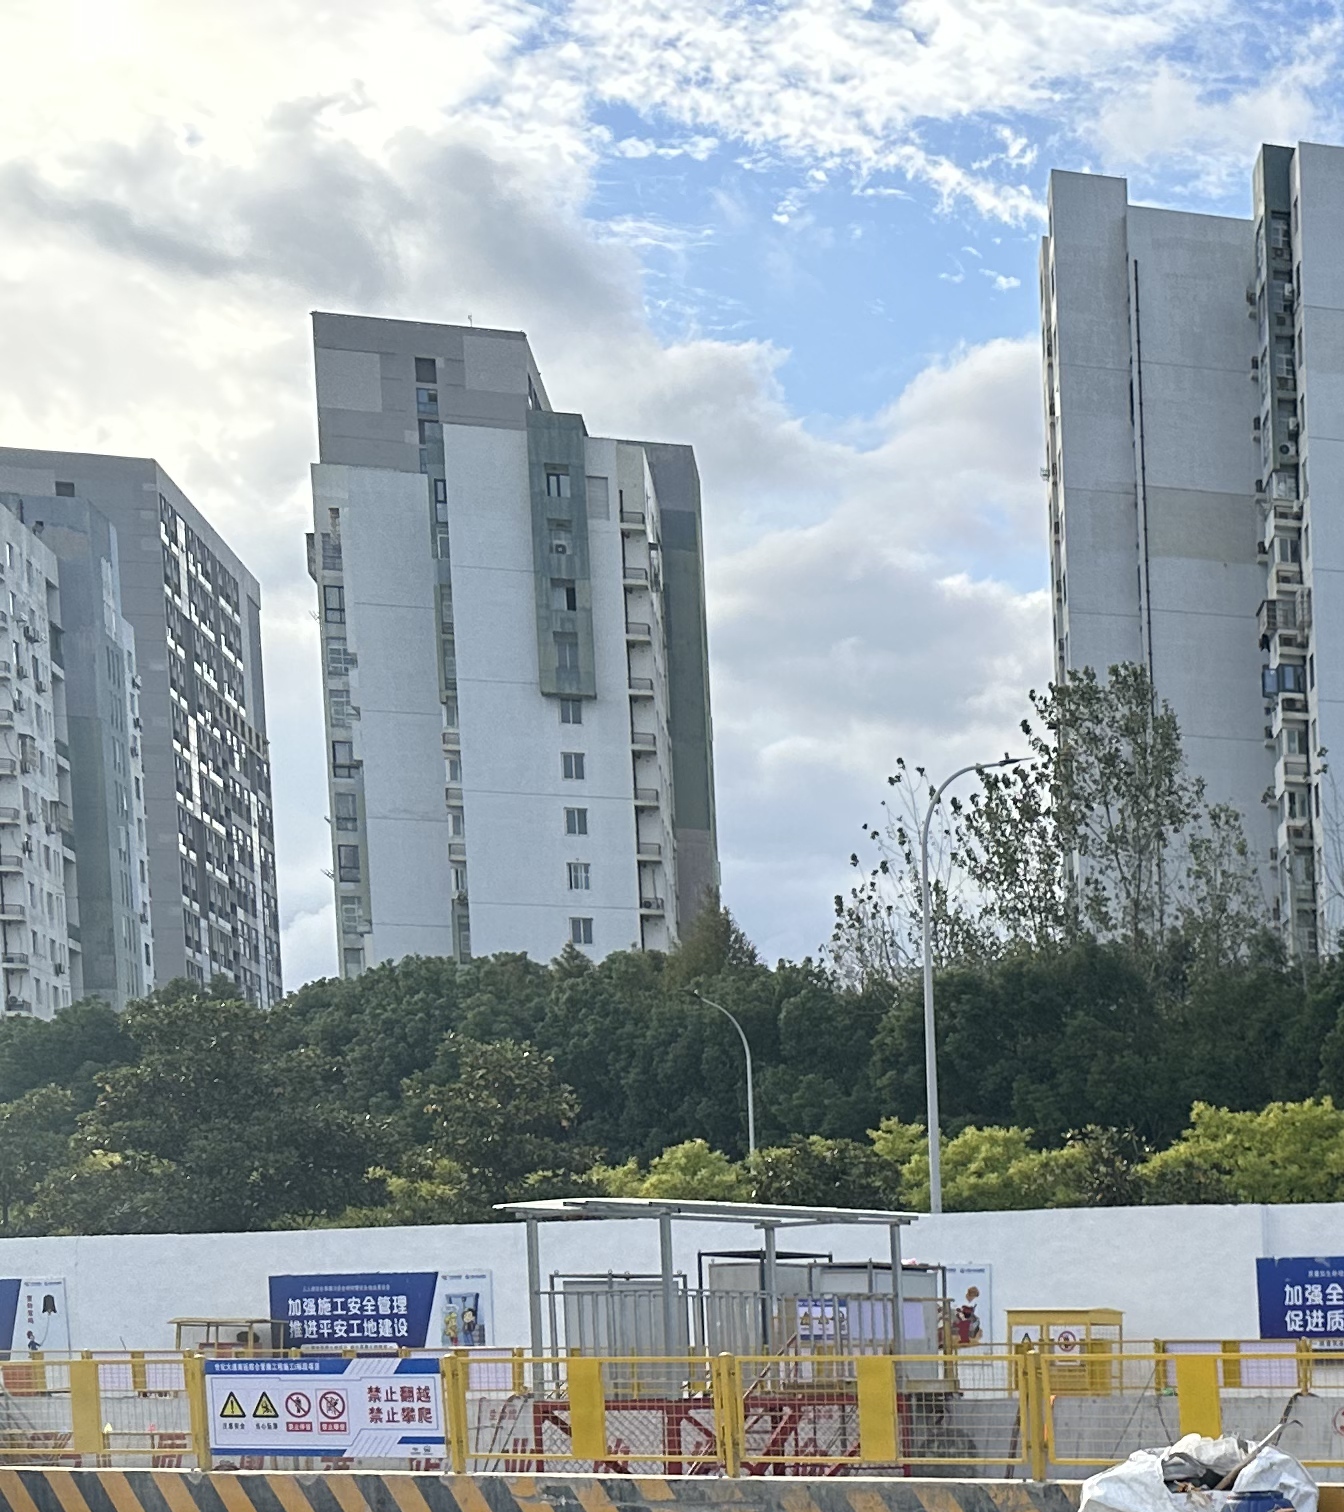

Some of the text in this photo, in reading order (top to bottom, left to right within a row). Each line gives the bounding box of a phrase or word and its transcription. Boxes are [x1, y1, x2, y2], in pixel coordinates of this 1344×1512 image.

[288, 1295, 408, 1316] 加强施工安全管理
[289, 1318, 408, 1338] 推进平安工地建设
[367, 1385, 431, 1404] 禁止翻越
[368, 1406, 433, 1425] 禁止攀爬
